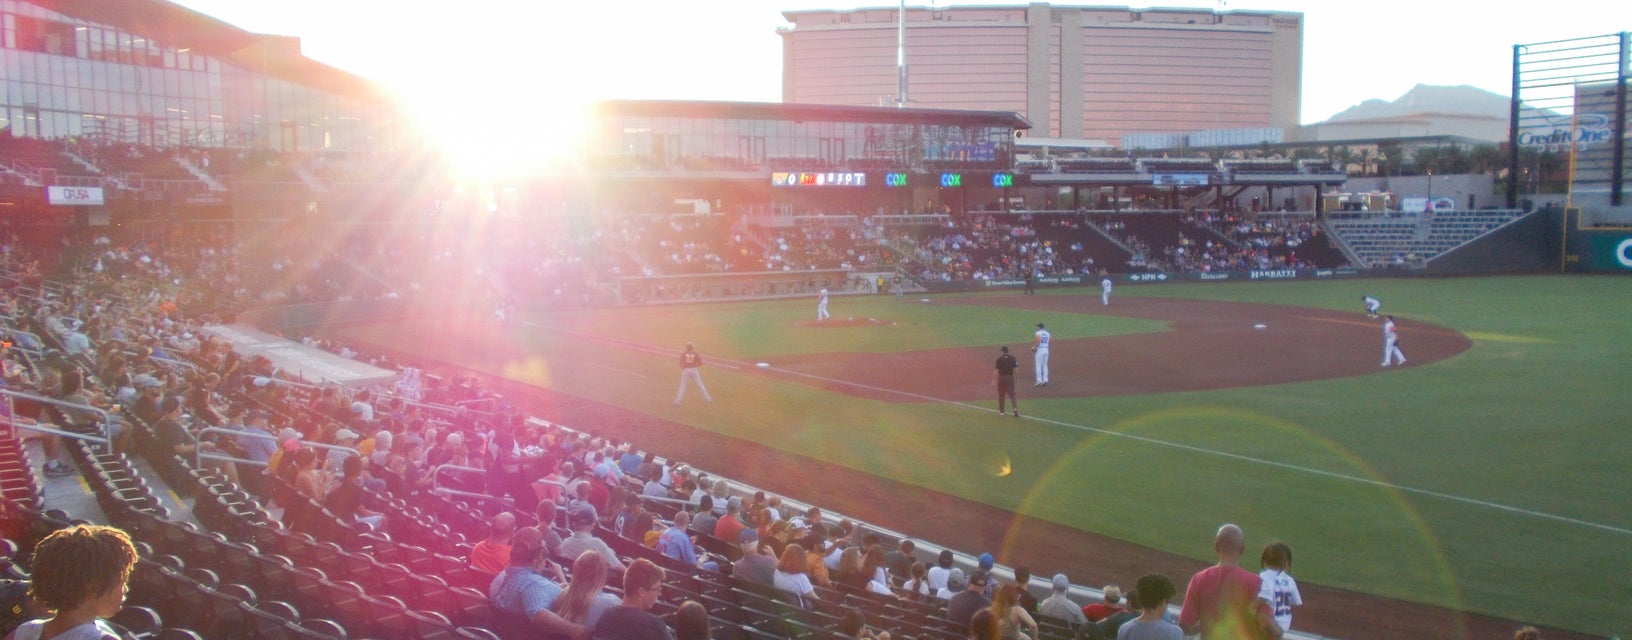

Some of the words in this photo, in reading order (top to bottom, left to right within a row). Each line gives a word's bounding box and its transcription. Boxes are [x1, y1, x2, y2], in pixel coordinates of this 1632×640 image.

[886, 173, 906, 186] COX
[941, 174, 960, 186] COX
[993, 174, 1012, 186] COX
